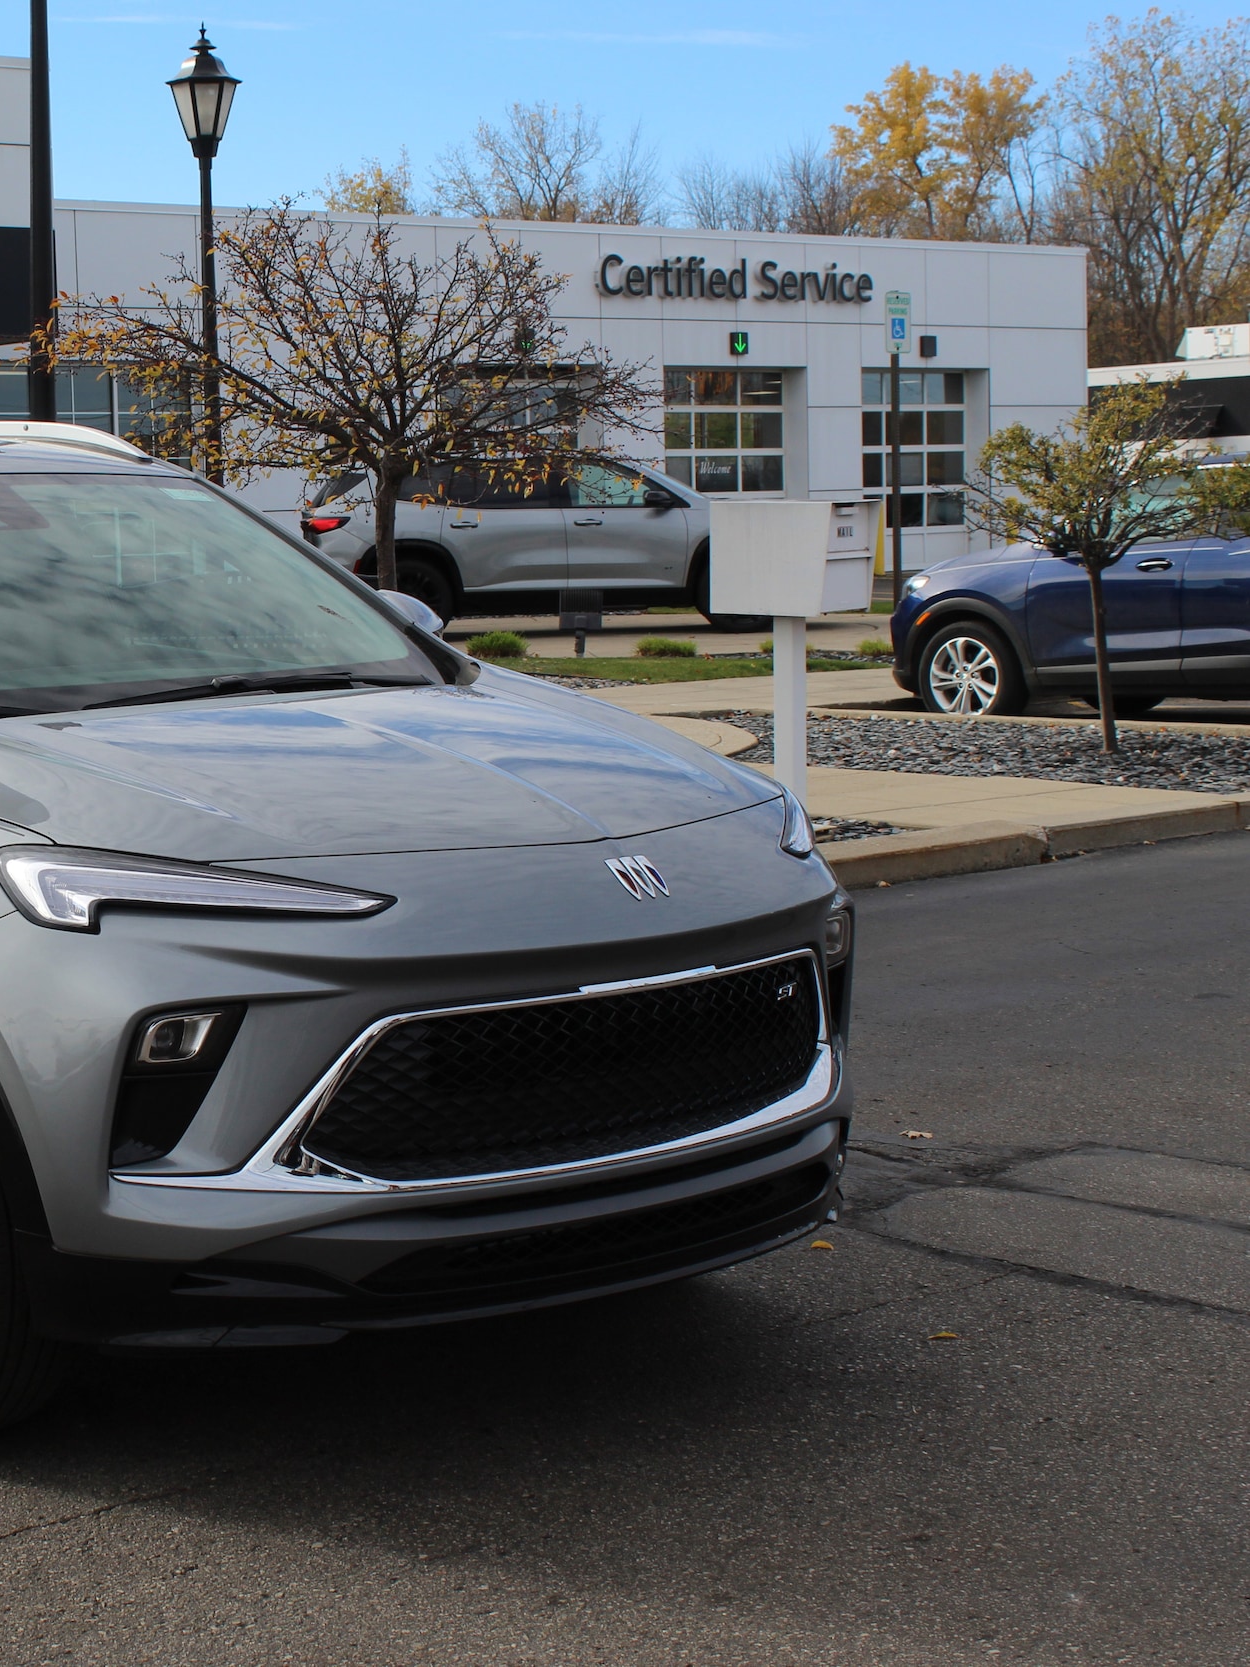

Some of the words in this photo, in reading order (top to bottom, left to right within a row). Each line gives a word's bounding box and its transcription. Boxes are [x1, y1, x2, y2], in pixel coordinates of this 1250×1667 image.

[598, 253, 748, 300] Certified
[756, 260, 874, 303] Service
[700, 461, 732, 474] Welcome
[837, 526, 853, 538] MAIL
[777, 982, 797, 1001] ST
